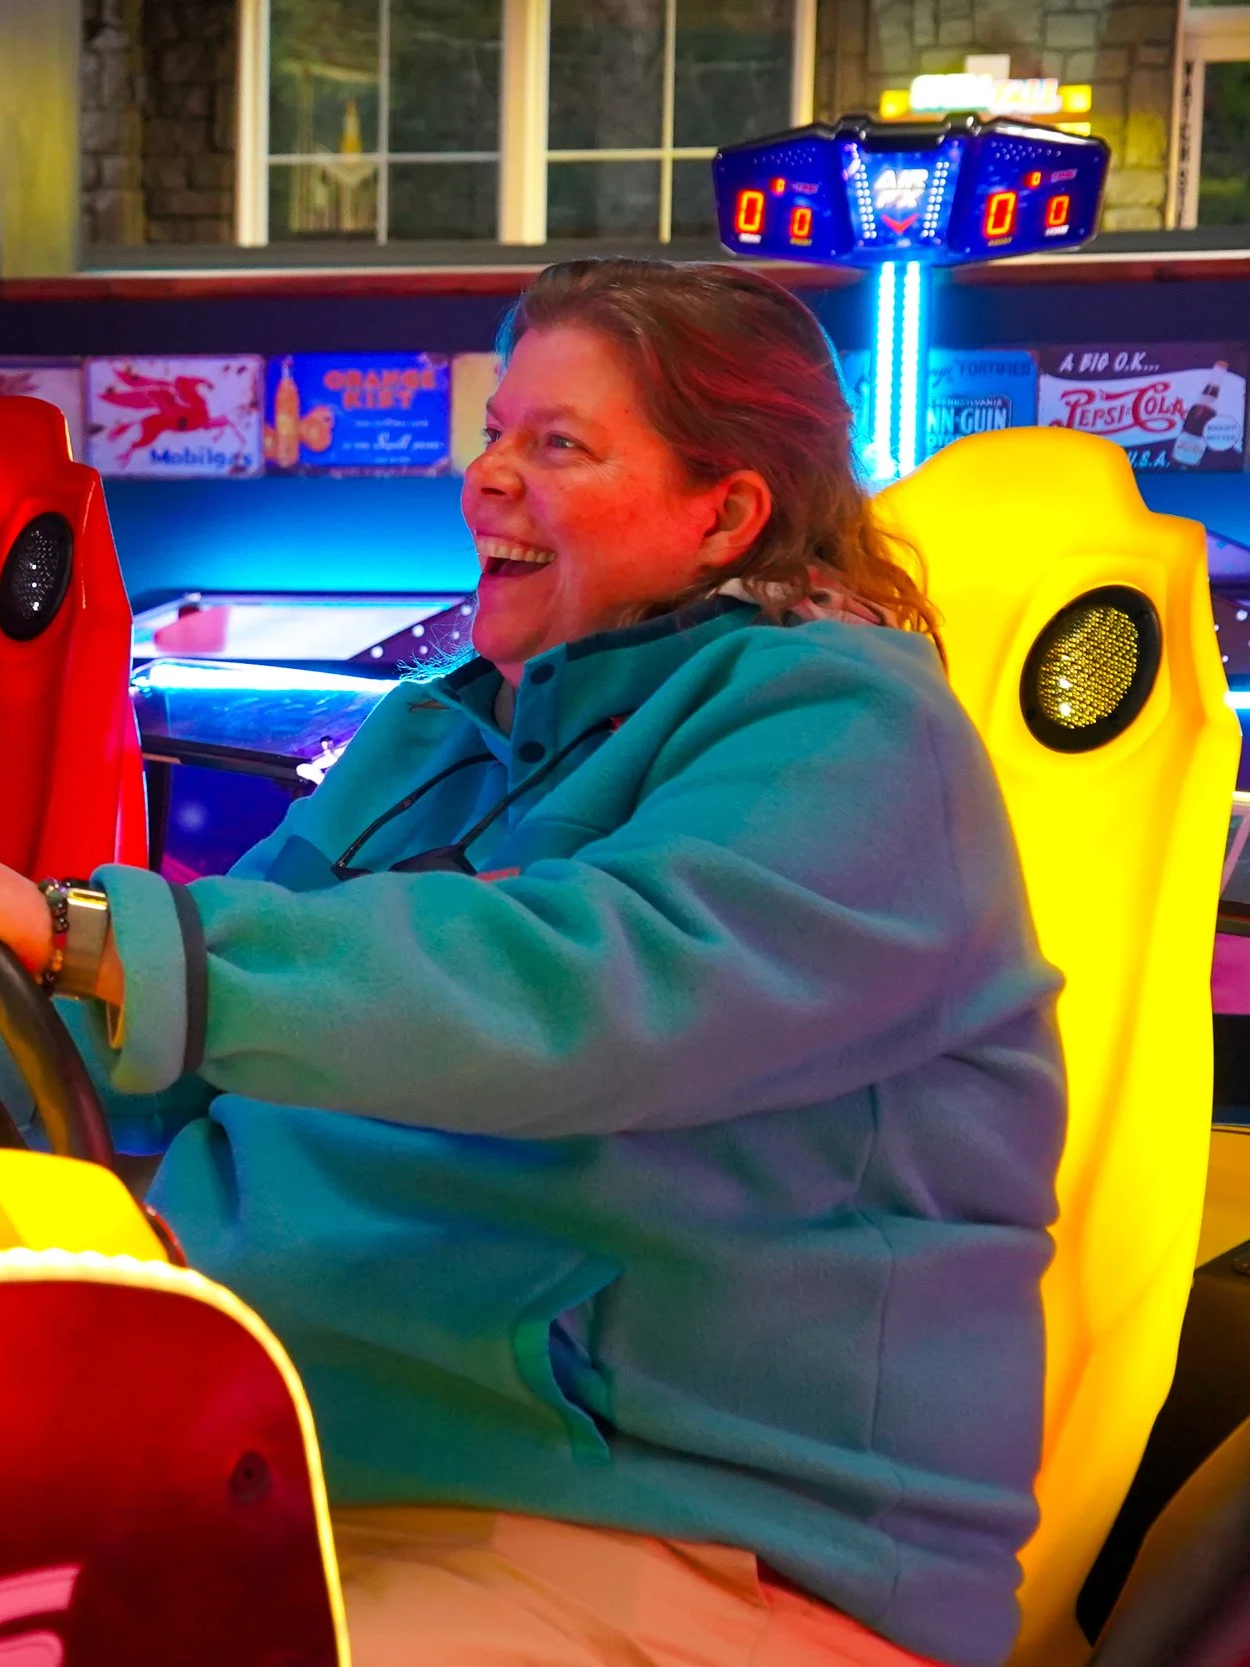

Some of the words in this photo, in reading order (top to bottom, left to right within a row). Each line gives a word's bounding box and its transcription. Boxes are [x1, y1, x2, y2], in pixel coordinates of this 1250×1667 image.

[738, 191, 764, 232] 0
[793, 207, 811, 237] 0
[986, 192, 1016, 236] 0
[1048, 195, 1069, 225] 0
[1059, 353, 1074, 373] A
[1078, 352, 1109, 373] BIG
[324, 369, 435, 391] ORANGE
